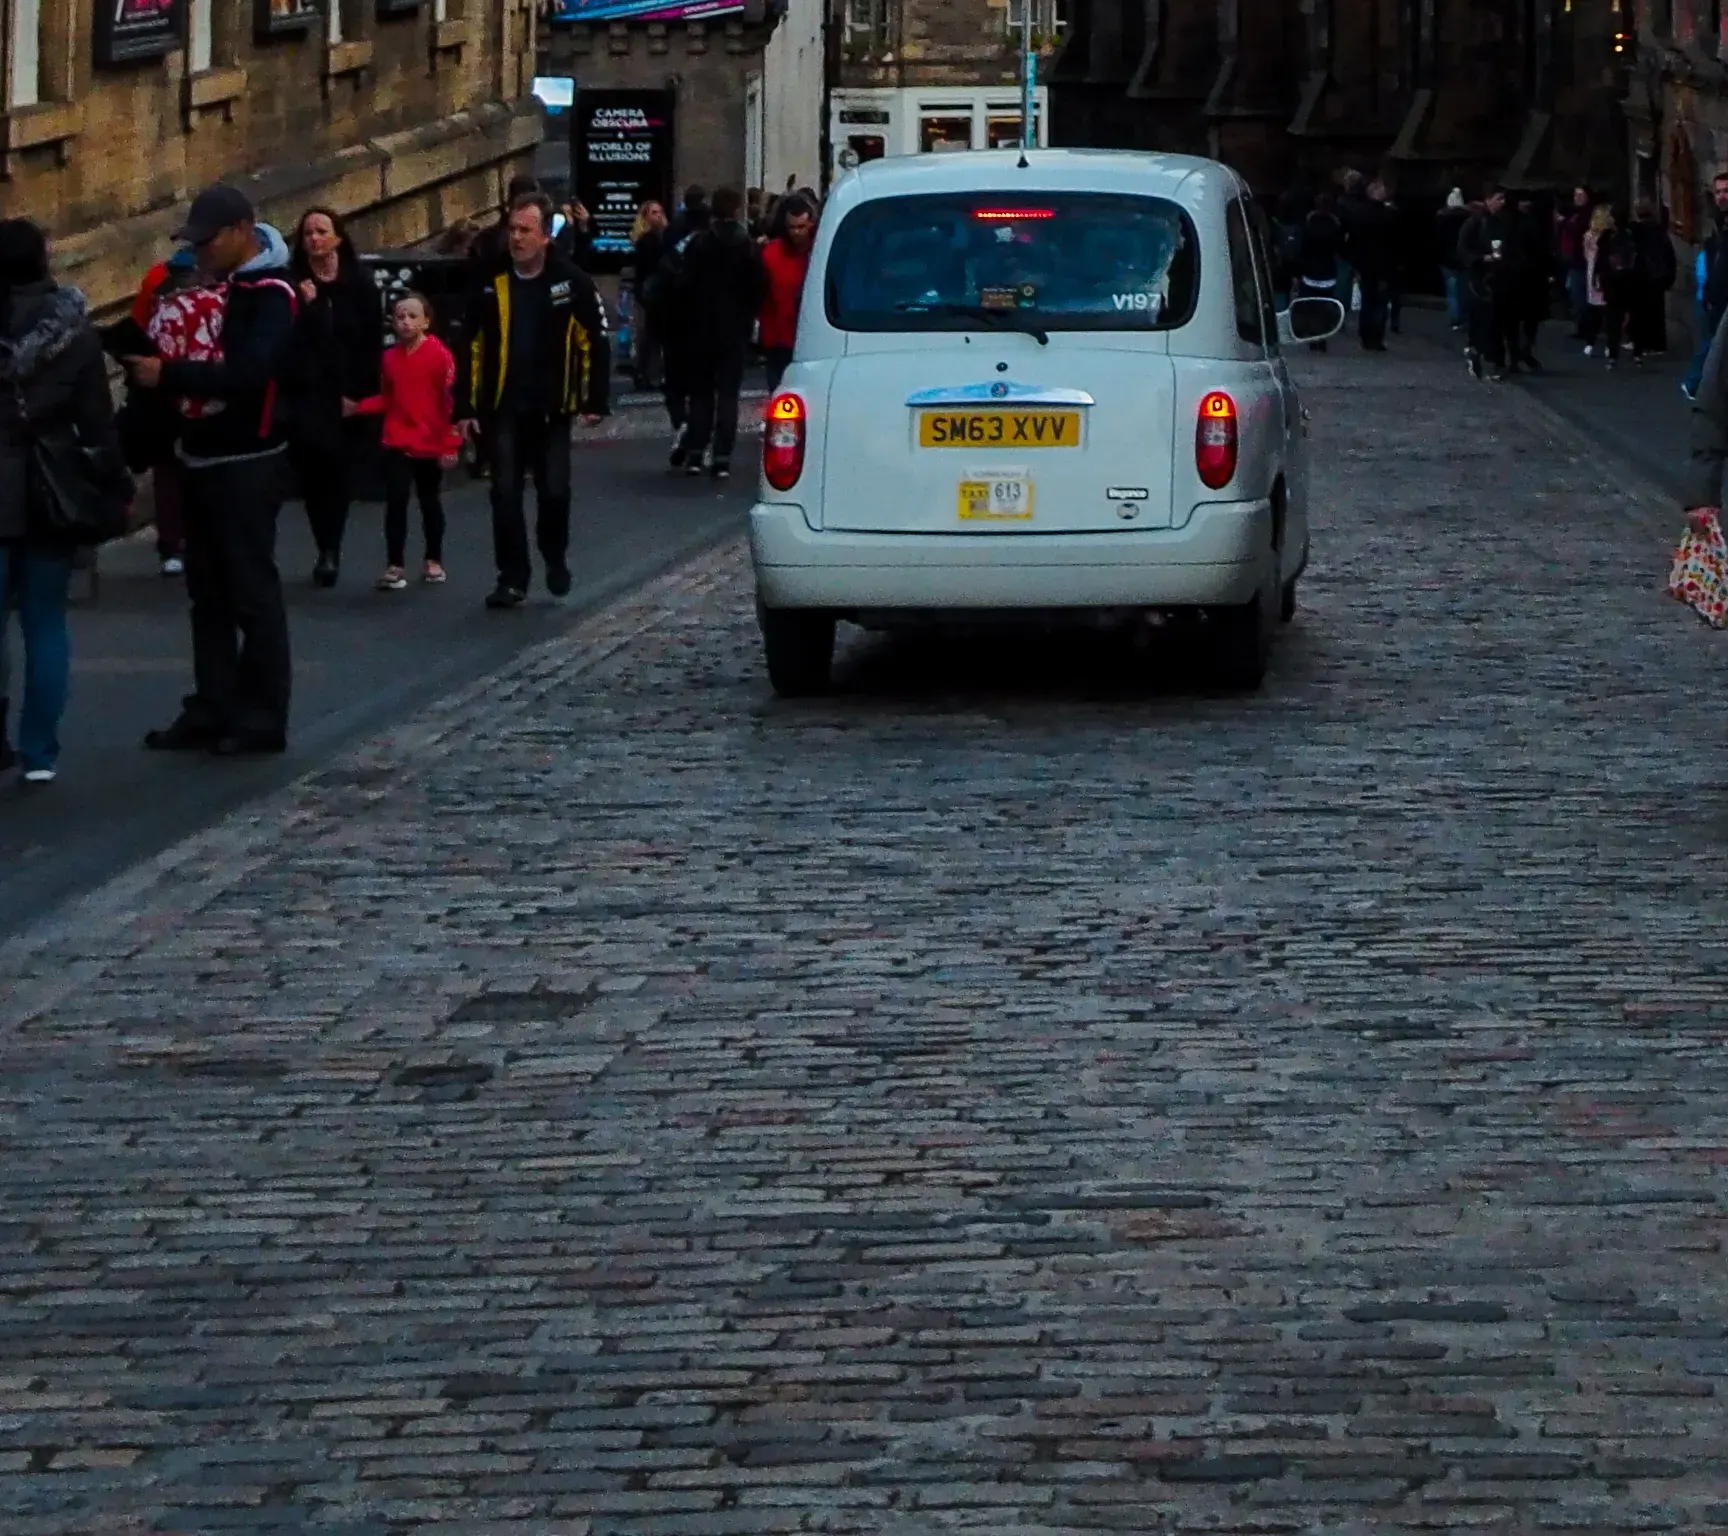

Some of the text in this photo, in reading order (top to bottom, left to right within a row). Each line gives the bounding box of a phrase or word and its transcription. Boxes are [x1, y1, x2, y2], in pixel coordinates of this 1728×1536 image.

[596, 108, 645, 118] CAMERA
[591, 118, 649, 128] OBSCURA
[587, 141, 652, 151] WORLD OF
[587, 151, 652, 162] ILLUSIONS
[1112, 292, 1162, 311] V197
[931, 415, 1066, 442] SM63 XVV
[994, 482, 1021, 500] 613
